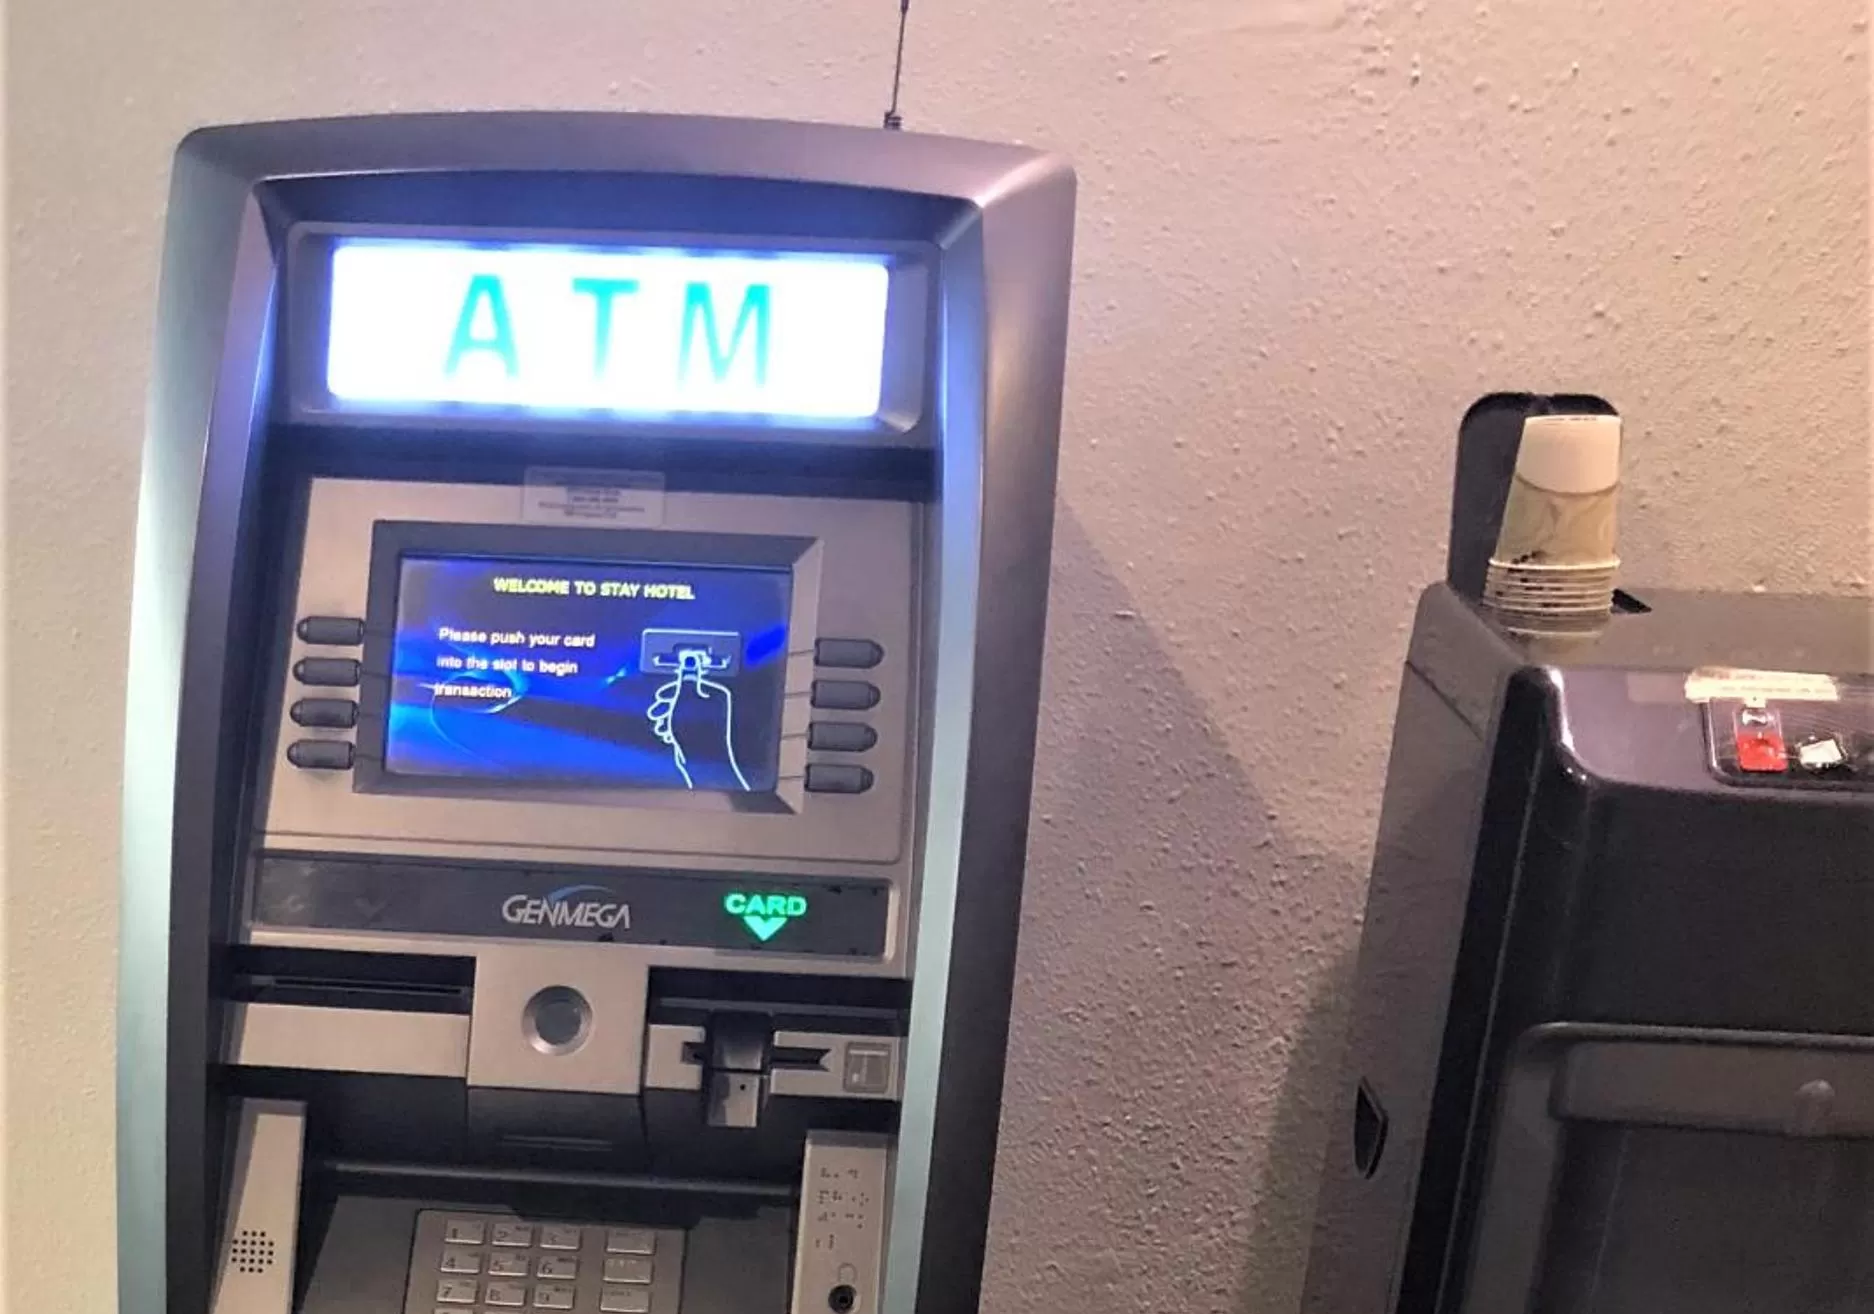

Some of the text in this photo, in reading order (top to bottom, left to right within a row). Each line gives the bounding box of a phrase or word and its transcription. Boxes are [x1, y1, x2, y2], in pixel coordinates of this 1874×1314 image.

[444, 273, 772, 389] ATM
[493, 576, 695, 601] WELCOME TO STAY HOTEL
[438, 627, 596, 649] Please push your card
[436, 656, 578, 676] into the slot to begin
[433, 683, 513, 700] transaction
[502, 894, 632, 931] GENMEGA
[725, 892, 808, 919] CARD
